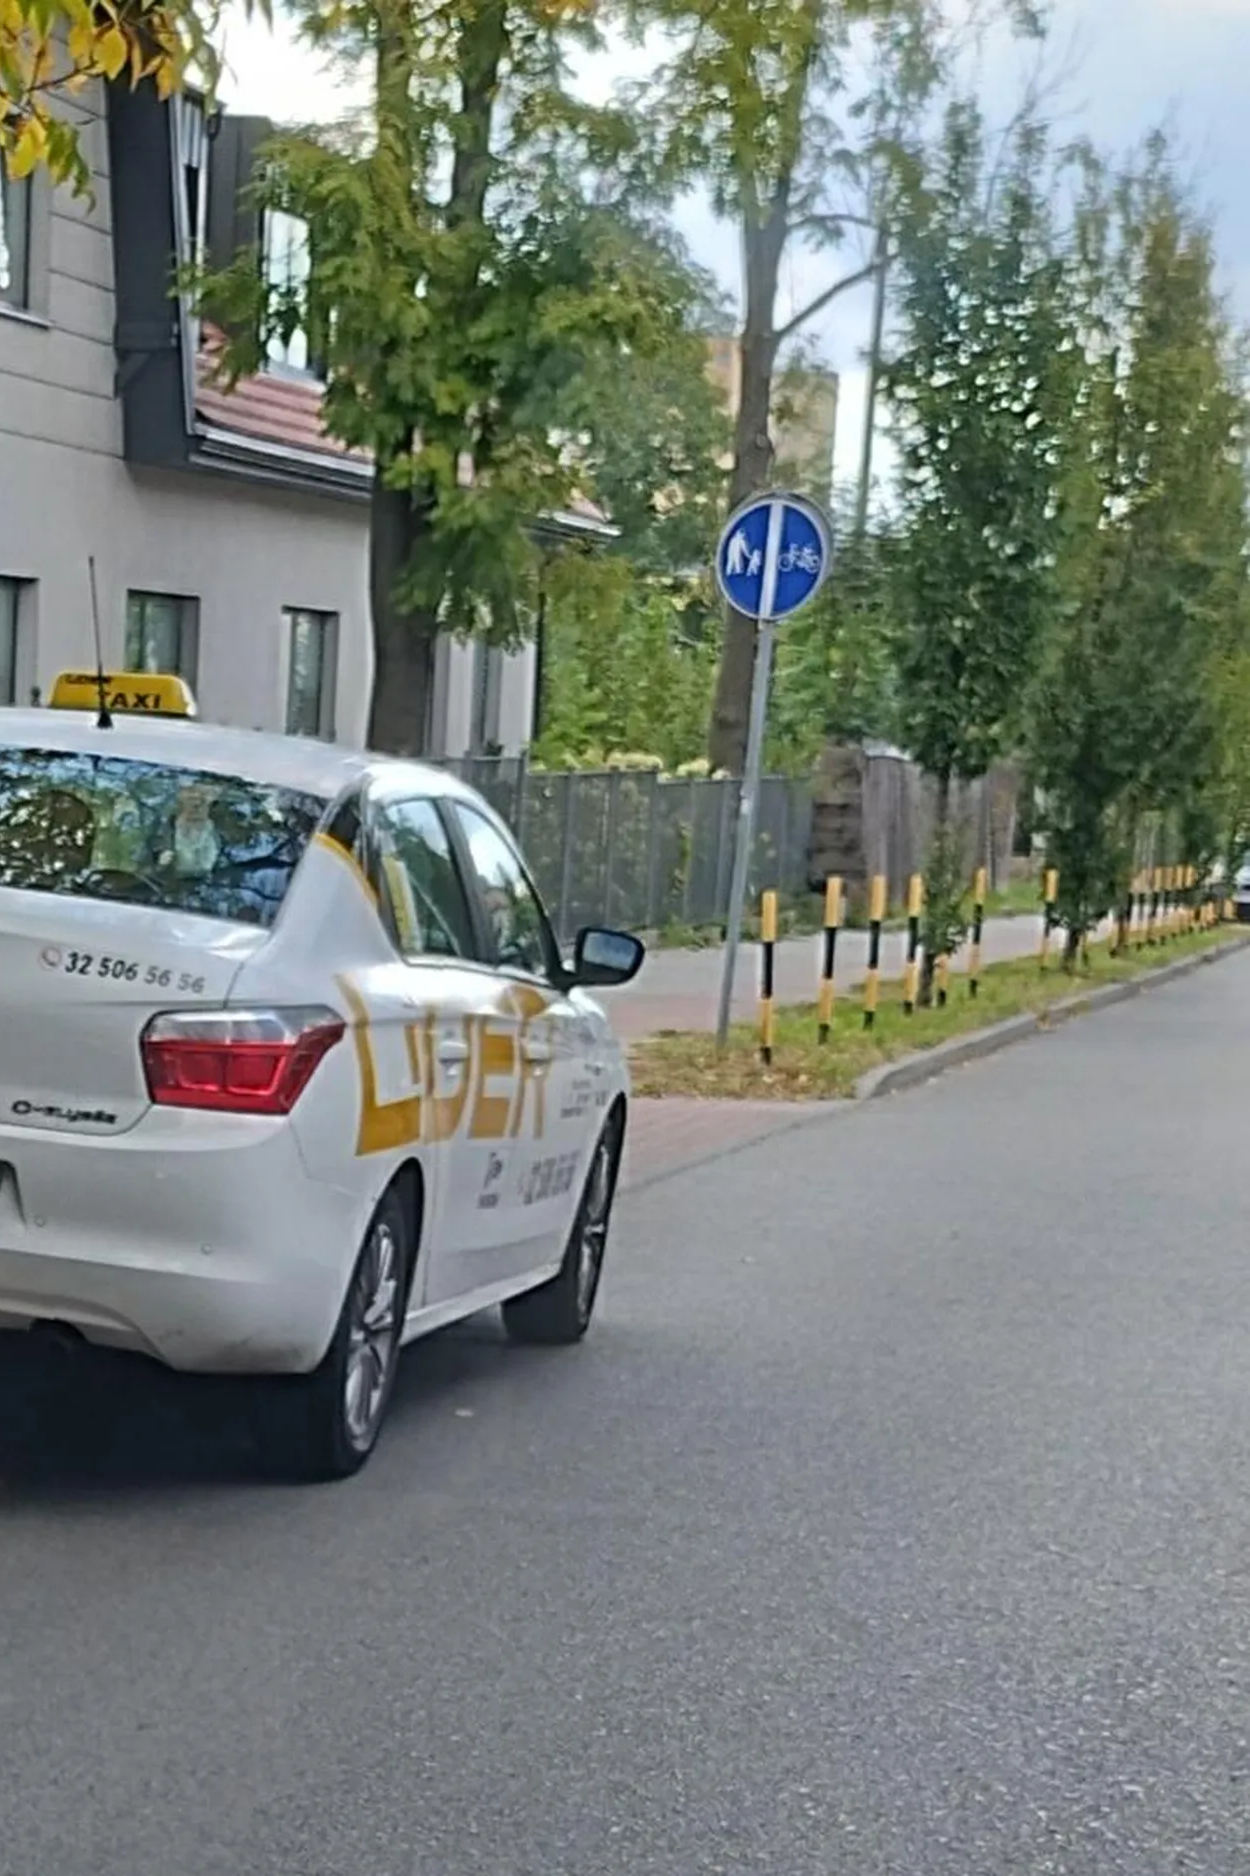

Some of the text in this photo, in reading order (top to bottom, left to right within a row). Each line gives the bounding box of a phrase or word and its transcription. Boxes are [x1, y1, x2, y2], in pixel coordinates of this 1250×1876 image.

[98, 691, 162, 709] TAXI
[65, 951, 206, 994] 32 506 56 56
